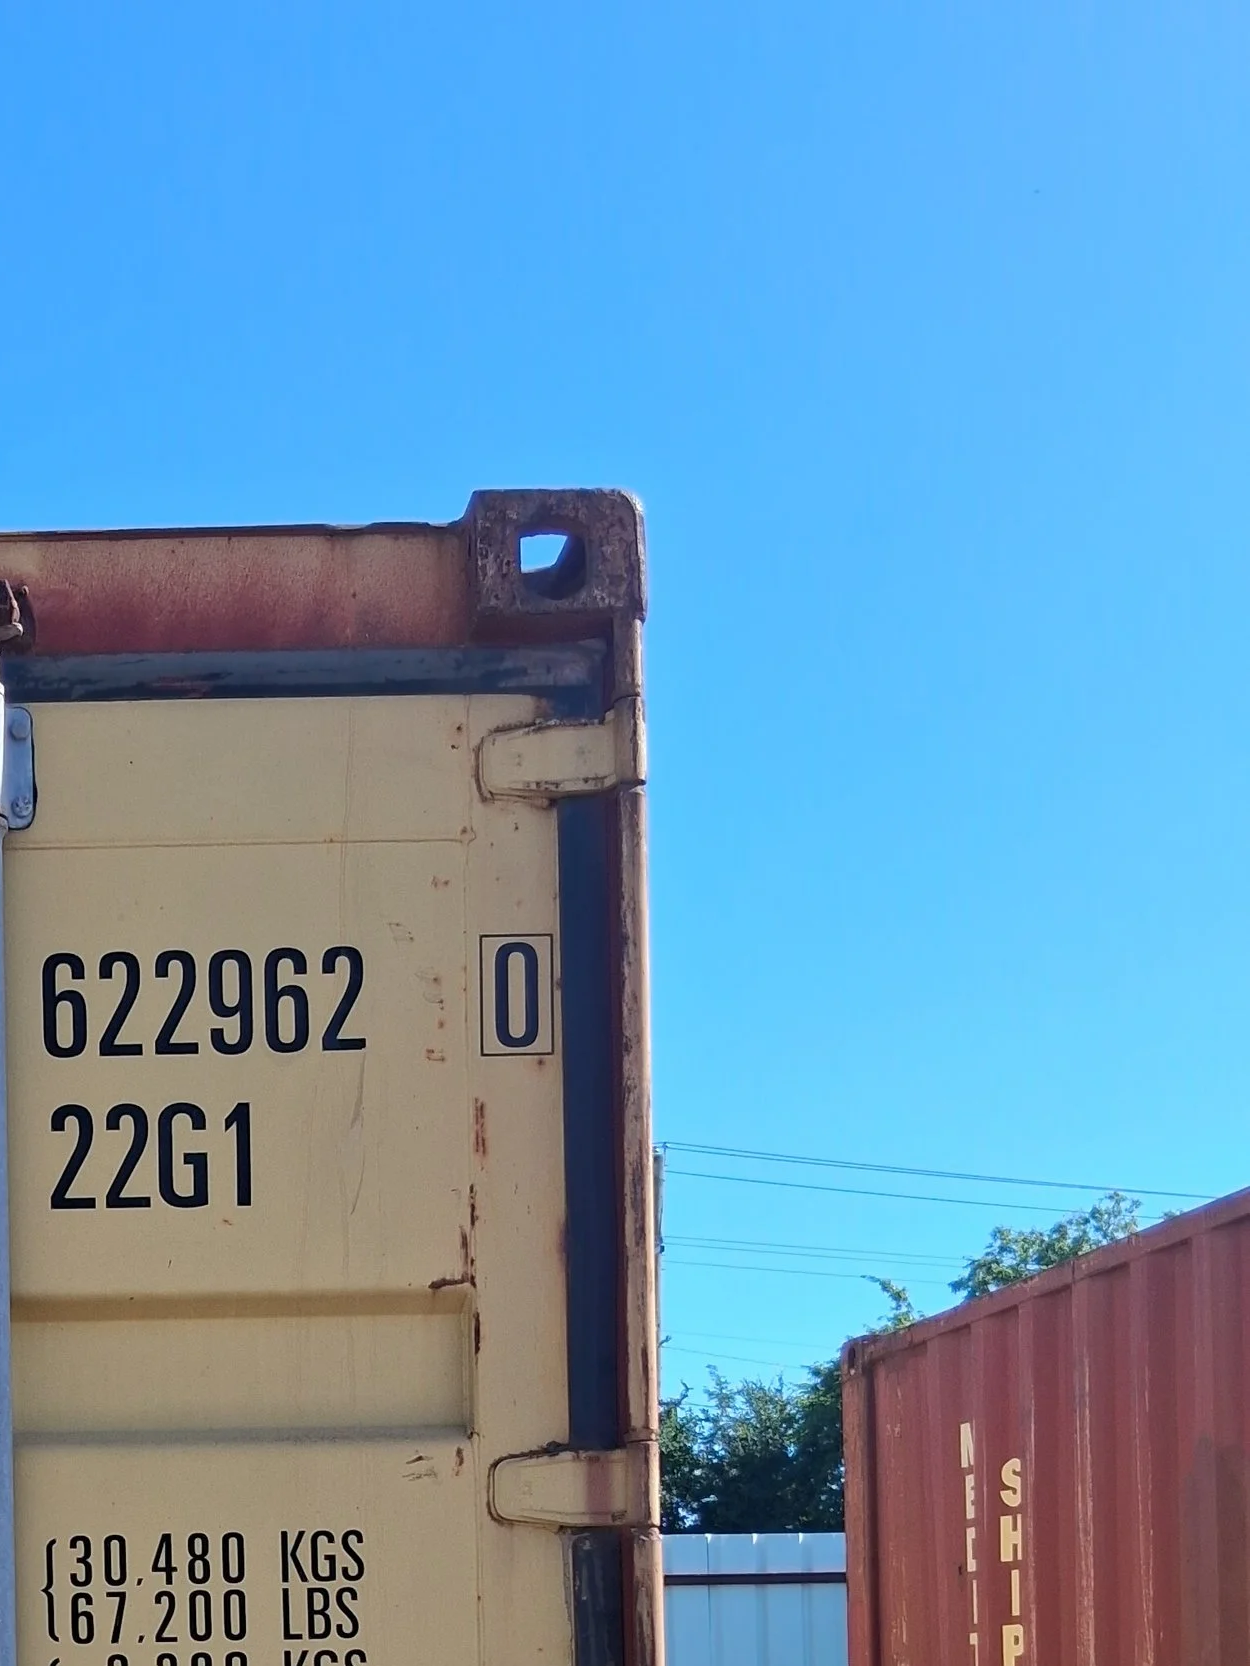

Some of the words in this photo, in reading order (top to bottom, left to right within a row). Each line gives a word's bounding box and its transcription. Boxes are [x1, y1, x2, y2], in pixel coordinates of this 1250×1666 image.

[41, 945, 367, 1060] 622962
[494, 941, 540, 1048] 0
[50, 1102, 252, 1210] 22G1
[69, 1531, 246, 1588] 30,480
[280, 1529, 366, 1583] KGS
[70, 1589, 248, 1645] 67,200
[282, 1586, 361, 1641] LBS
